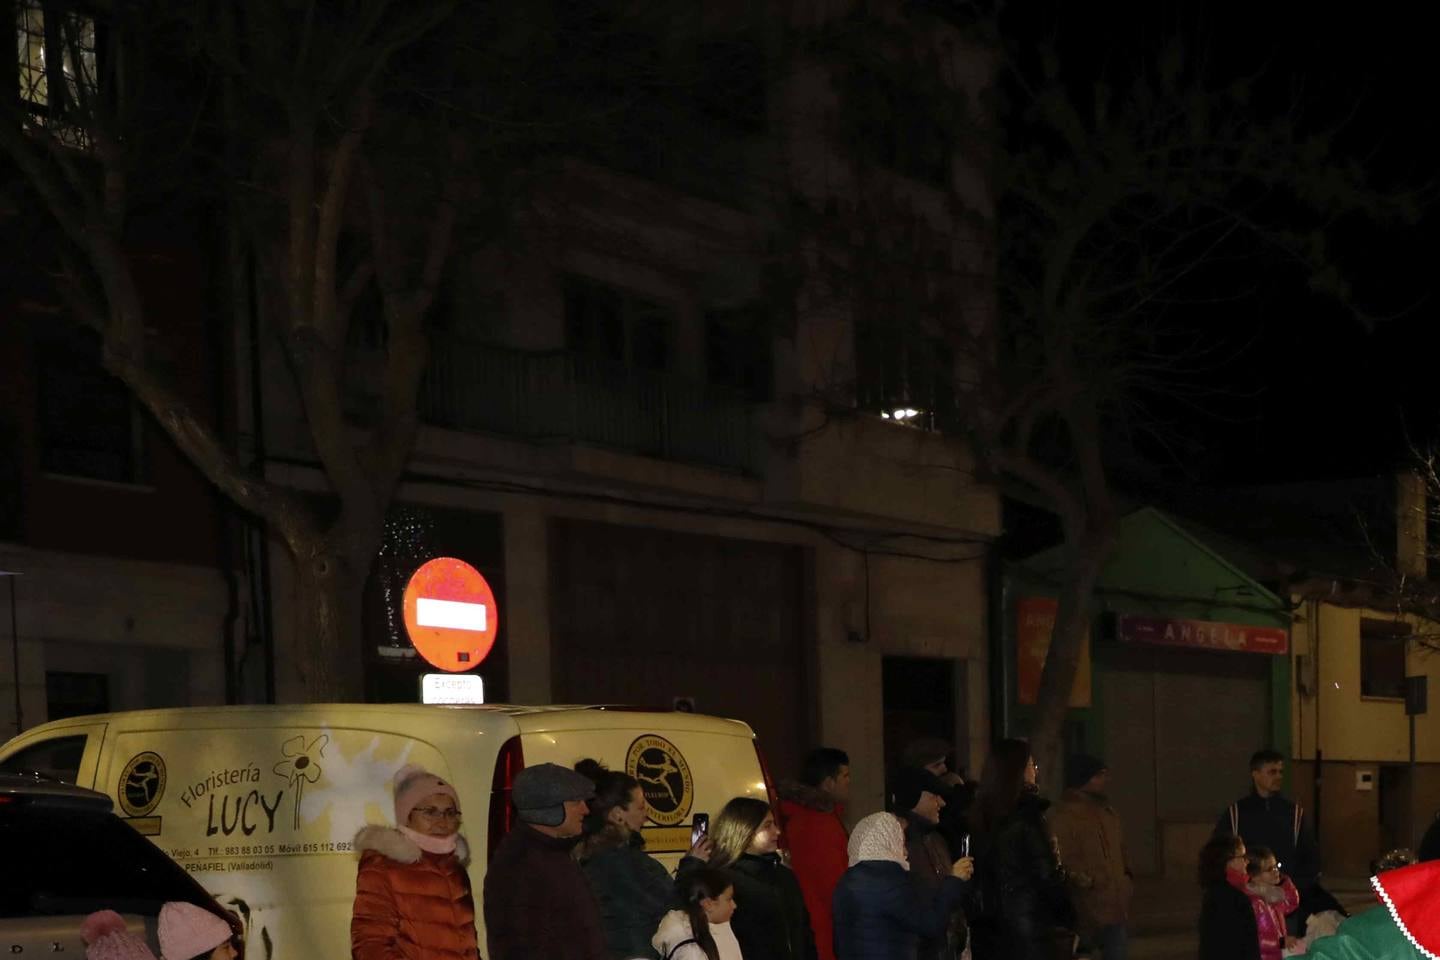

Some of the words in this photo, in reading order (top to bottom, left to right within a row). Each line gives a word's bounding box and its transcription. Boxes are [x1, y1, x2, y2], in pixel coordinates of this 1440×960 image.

[181, 762, 260, 808] Floristería
[206, 790, 283, 837] LUCY
[302, 843, 319, 852] 615
[320, 842, 335, 852] 112
[336, 841, 352, 851] 692
